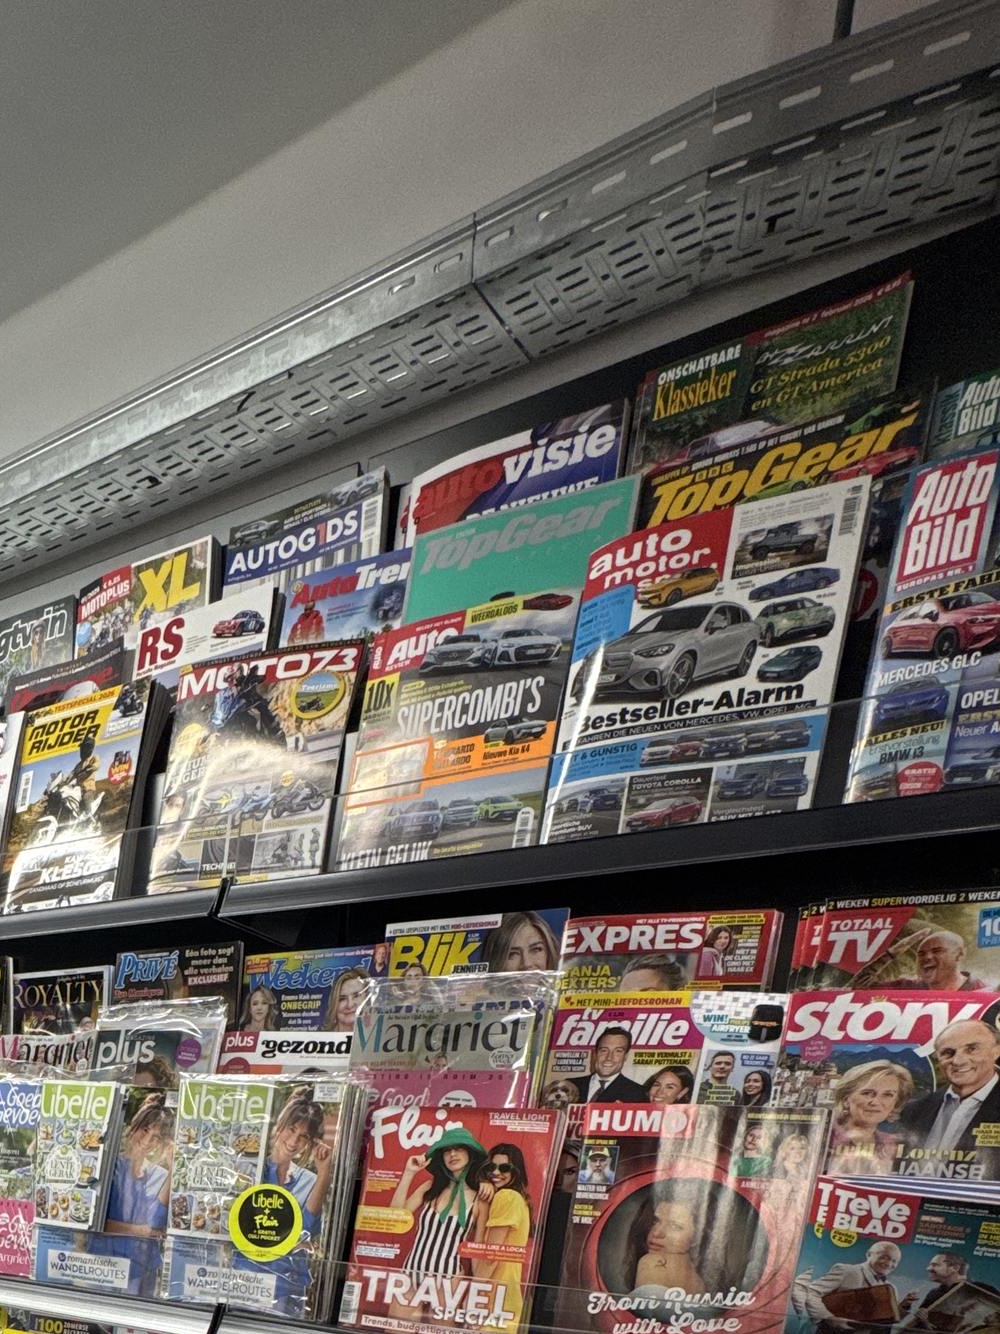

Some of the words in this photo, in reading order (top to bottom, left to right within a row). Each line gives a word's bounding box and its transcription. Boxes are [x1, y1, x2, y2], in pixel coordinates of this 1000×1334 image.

[657, 343, 742, 386] ONSCHATBARE
[779, 354, 841, 384] Strada
[845, 335, 892, 367] 5300
[807, 357, 885, 392] America
[652, 367, 736, 422] Klassieker
[958, 399, 999, 436] Bild
[647, 412, 919, 528] TopGear
[907, 460, 998, 526] Auto
[419, 497, 621, 576] TopGear
[903, 508, 981, 577] Bild
[589, 528, 692, 580] auto
[603, 546, 711, 590] motor
[81, 580, 130, 619] MOTOPLUS
[133, 552, 201, 624] XL
[889, 582, 950, 613] ERSTE
[137, 617, 185, 672] RS
[181, 647, 359, 700] MOTO73
[875, 658, 950, 689] MERCEDES
[952, 651, 982, 670] GLC
[397, 676, 546, 739] SUPERCOMBI'S
[578, 683, 804, 734] Bestseller-Alarm
[28, 723, 101, 756] RIJDER
[29, 709, 100, 741] MOTOR
[630, 723, 659, 736] NEUEN
[662, 720, 684, 731] VON
[631, 780, 661, 792] TOYOTA
[663, 776, 702, 787] COROLLA
[836, 898, 870, 909] WEKEN
[872, 893, 956, 906] SUPERVOORDELIG
[563, 922, 704, 954] EXPRES
[830, 917, 894, 931] TOTAAL
[389, 931, 482, 980] Blik
[828, 929, 891, 963] TV
[116, 950, 180, 989] PRIVÉ
[188, 973, 229, 986] EXCLUSIEF
[251, 957, 374, 991] Weekend
[452, 964, 488, 974] JENNIFER
[14, 979, 102, 1008] ROYALTY
[281, 1000, 321, 1010] ONBEGRIP
[356, 1012, 526, 1055] Margriet
[556, 1009, 691, 1047] familie
[703, 1013, 729, 1023] WIN!
[786, 992, 983, 1058] story
[100, 1028, 155, 1064] plus
[225, 1033, 254, 1050] plus
[261, 1034, 352, 1058] gezond
[7, 1086, 41, 1106] Goed
[42, 1082, 106, 1120] Libelle
[370, 1106, 463, 1159] Flair
[489, 1112, 521, 1122] TRAVEL
[523, 1113, 551, 1123] LIGHT
[589, 1109, 688, 1133] HUMO
[252, 1193, 284, 1210] Libelle
[835, 1188, 911, 1222] TeVe
[833, 1213, 907, 1238] BLAD
[51, 1262, 126, 1280] WANDELROUTES
[67, 1254, 118, 1268] romantische
[362, 1268, 514, 1322] TRAVEL
[587, 1291, 660, 1314] From
[664, 1286, 756, 1310] Russia
[38, 1318, 63, 1334] 100
[364, 1316, 395, 1329] Trends,
[433, 1305, 507, 1329] SPECIAL
